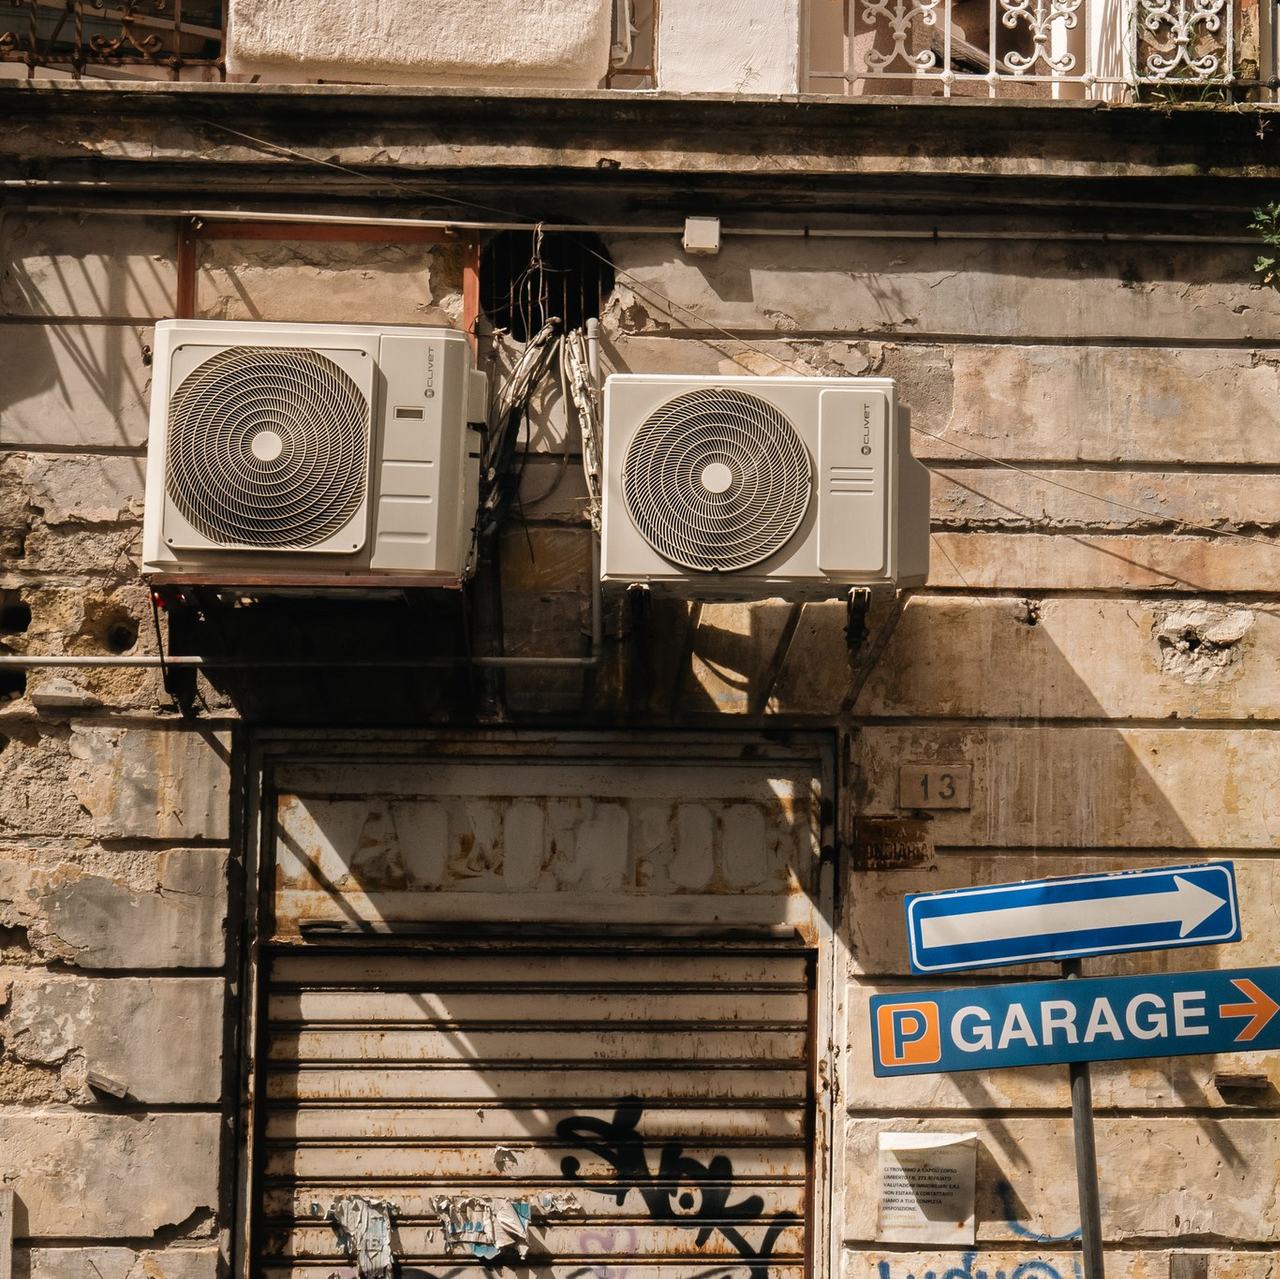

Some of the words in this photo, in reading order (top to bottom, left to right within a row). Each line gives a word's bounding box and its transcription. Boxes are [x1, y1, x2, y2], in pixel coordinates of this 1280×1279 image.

[921, 774, 956, 802] 13
[892, 1009, 928, 1060] P
[950, 990, 1210, 1052] GARAGE
